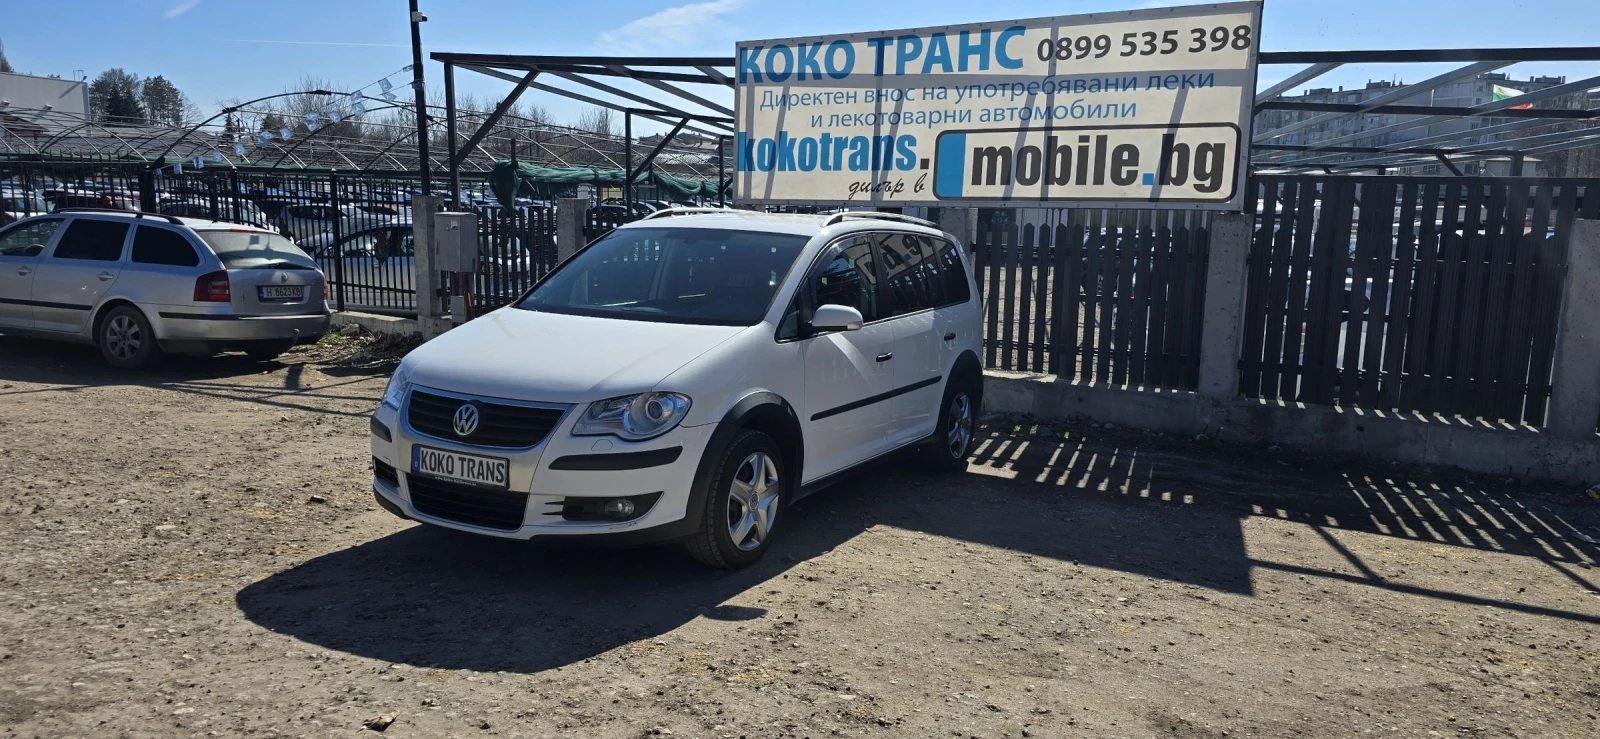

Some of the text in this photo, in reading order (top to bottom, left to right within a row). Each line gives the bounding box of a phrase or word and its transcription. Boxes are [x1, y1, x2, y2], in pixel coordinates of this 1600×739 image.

[739, 26, 1026, 84] КОКО ТРАНС
[1037, 25, 1251, 62] 0899 535 398
[760, 73, 1215, 111] Директен внос на употребявани леки
[811, 99, 1137, 129] и лекотоварни автомобили
[971, 133, 1226, 193] mobile.bg
[421, 450, 454, 475] KOKO
[458, 456, 505, 484] TRANS
